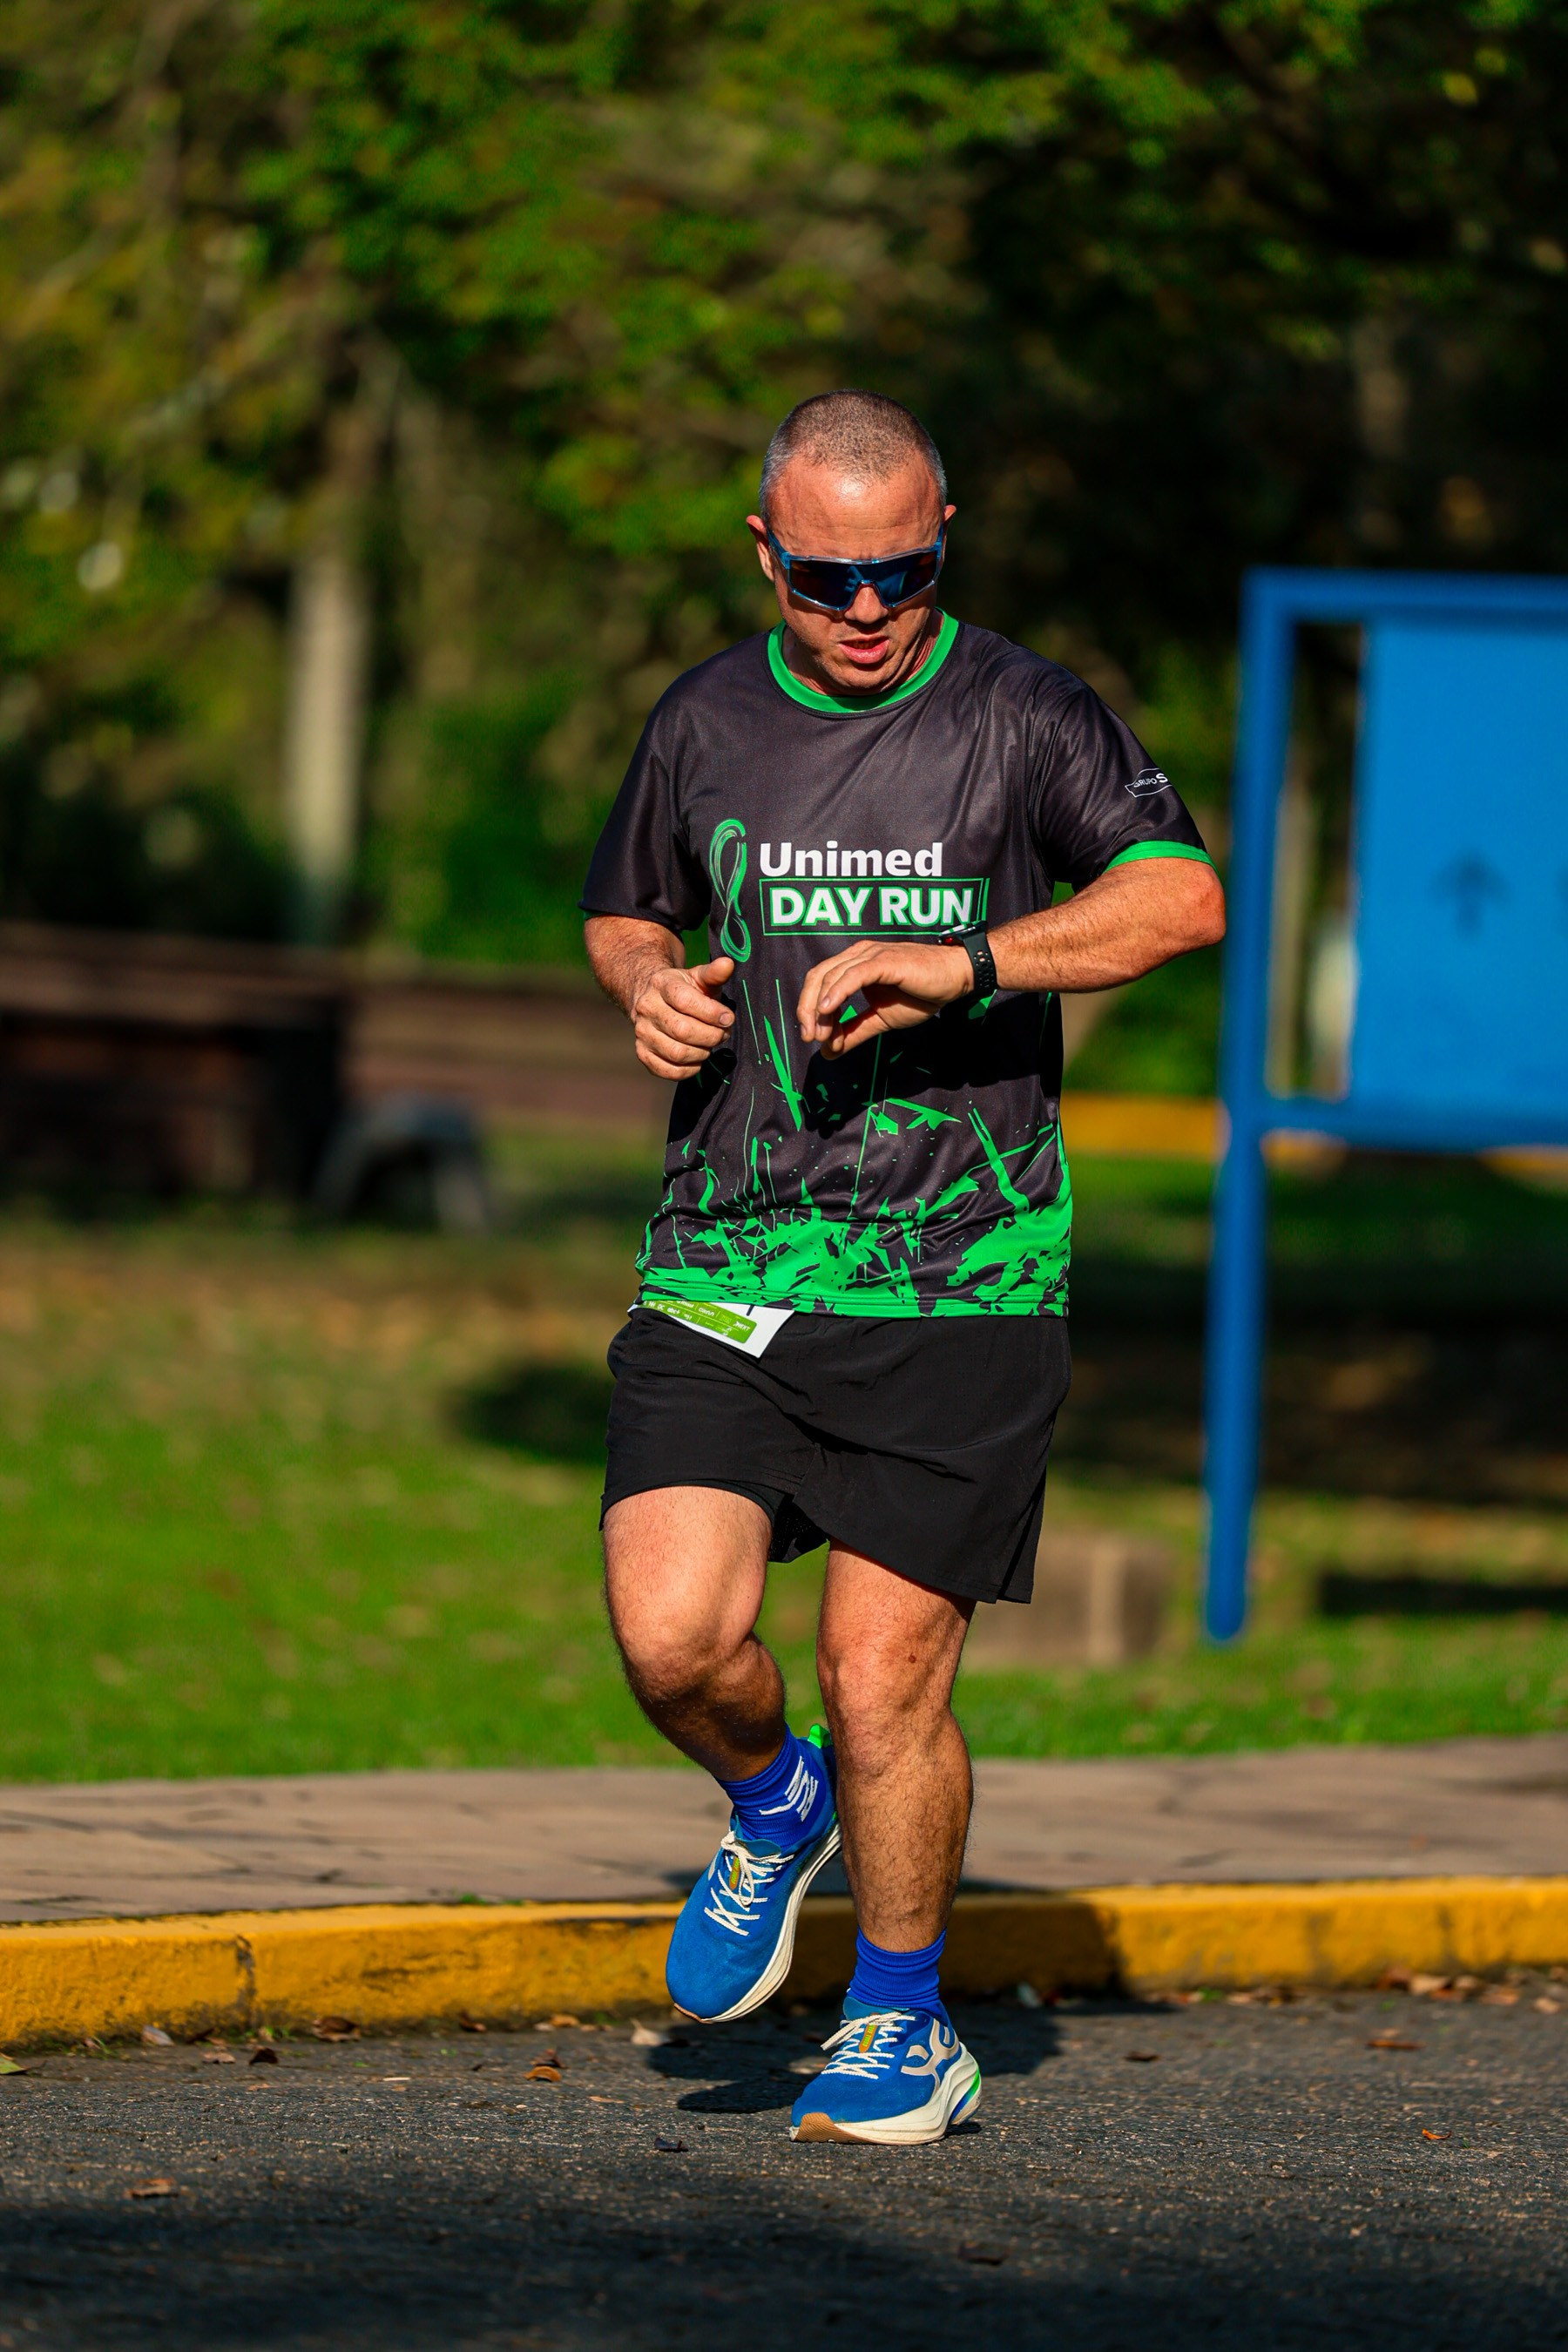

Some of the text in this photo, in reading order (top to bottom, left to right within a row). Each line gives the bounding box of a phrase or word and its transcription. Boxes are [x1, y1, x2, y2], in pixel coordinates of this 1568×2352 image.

[1133, 778, 1157, 788] GRUPO
[760, 841, 943, 877] Unimed
[769, 886, 974, 927] DAY RUN
